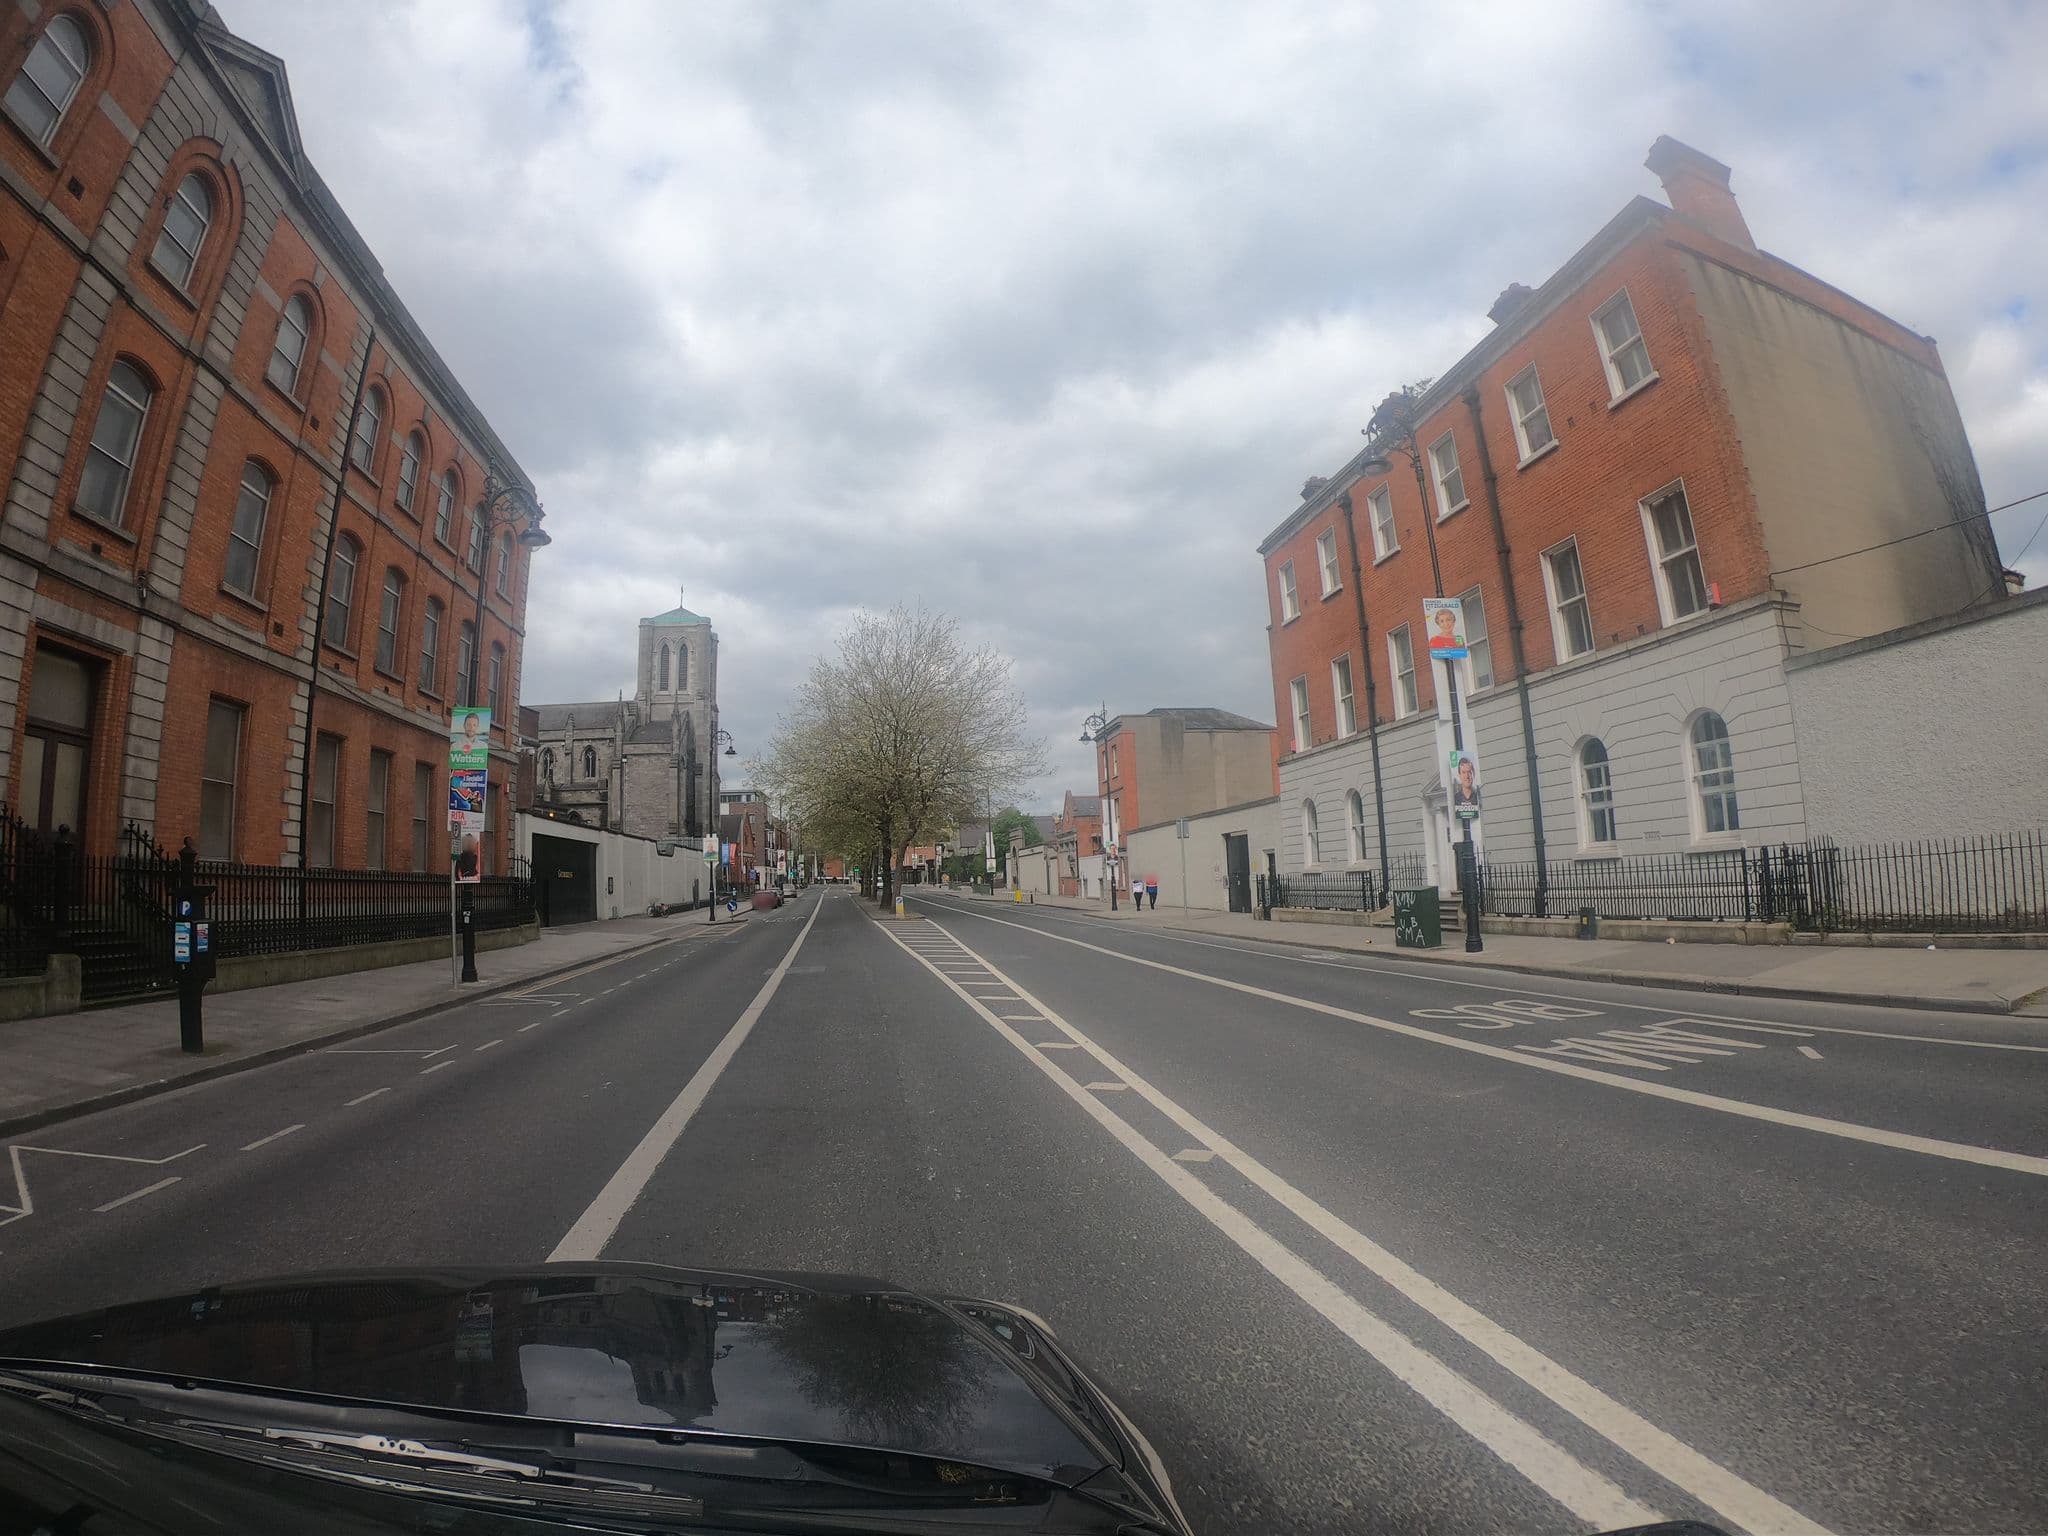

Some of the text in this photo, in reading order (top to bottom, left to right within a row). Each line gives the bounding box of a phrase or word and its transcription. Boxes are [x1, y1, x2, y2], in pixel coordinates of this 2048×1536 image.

[450, 753, 485, 763] Watters
[451, 811, 465, 819] RITA
[182, 901, 191, 915] P
[1408, 1000, 1606, 1030] BUS
